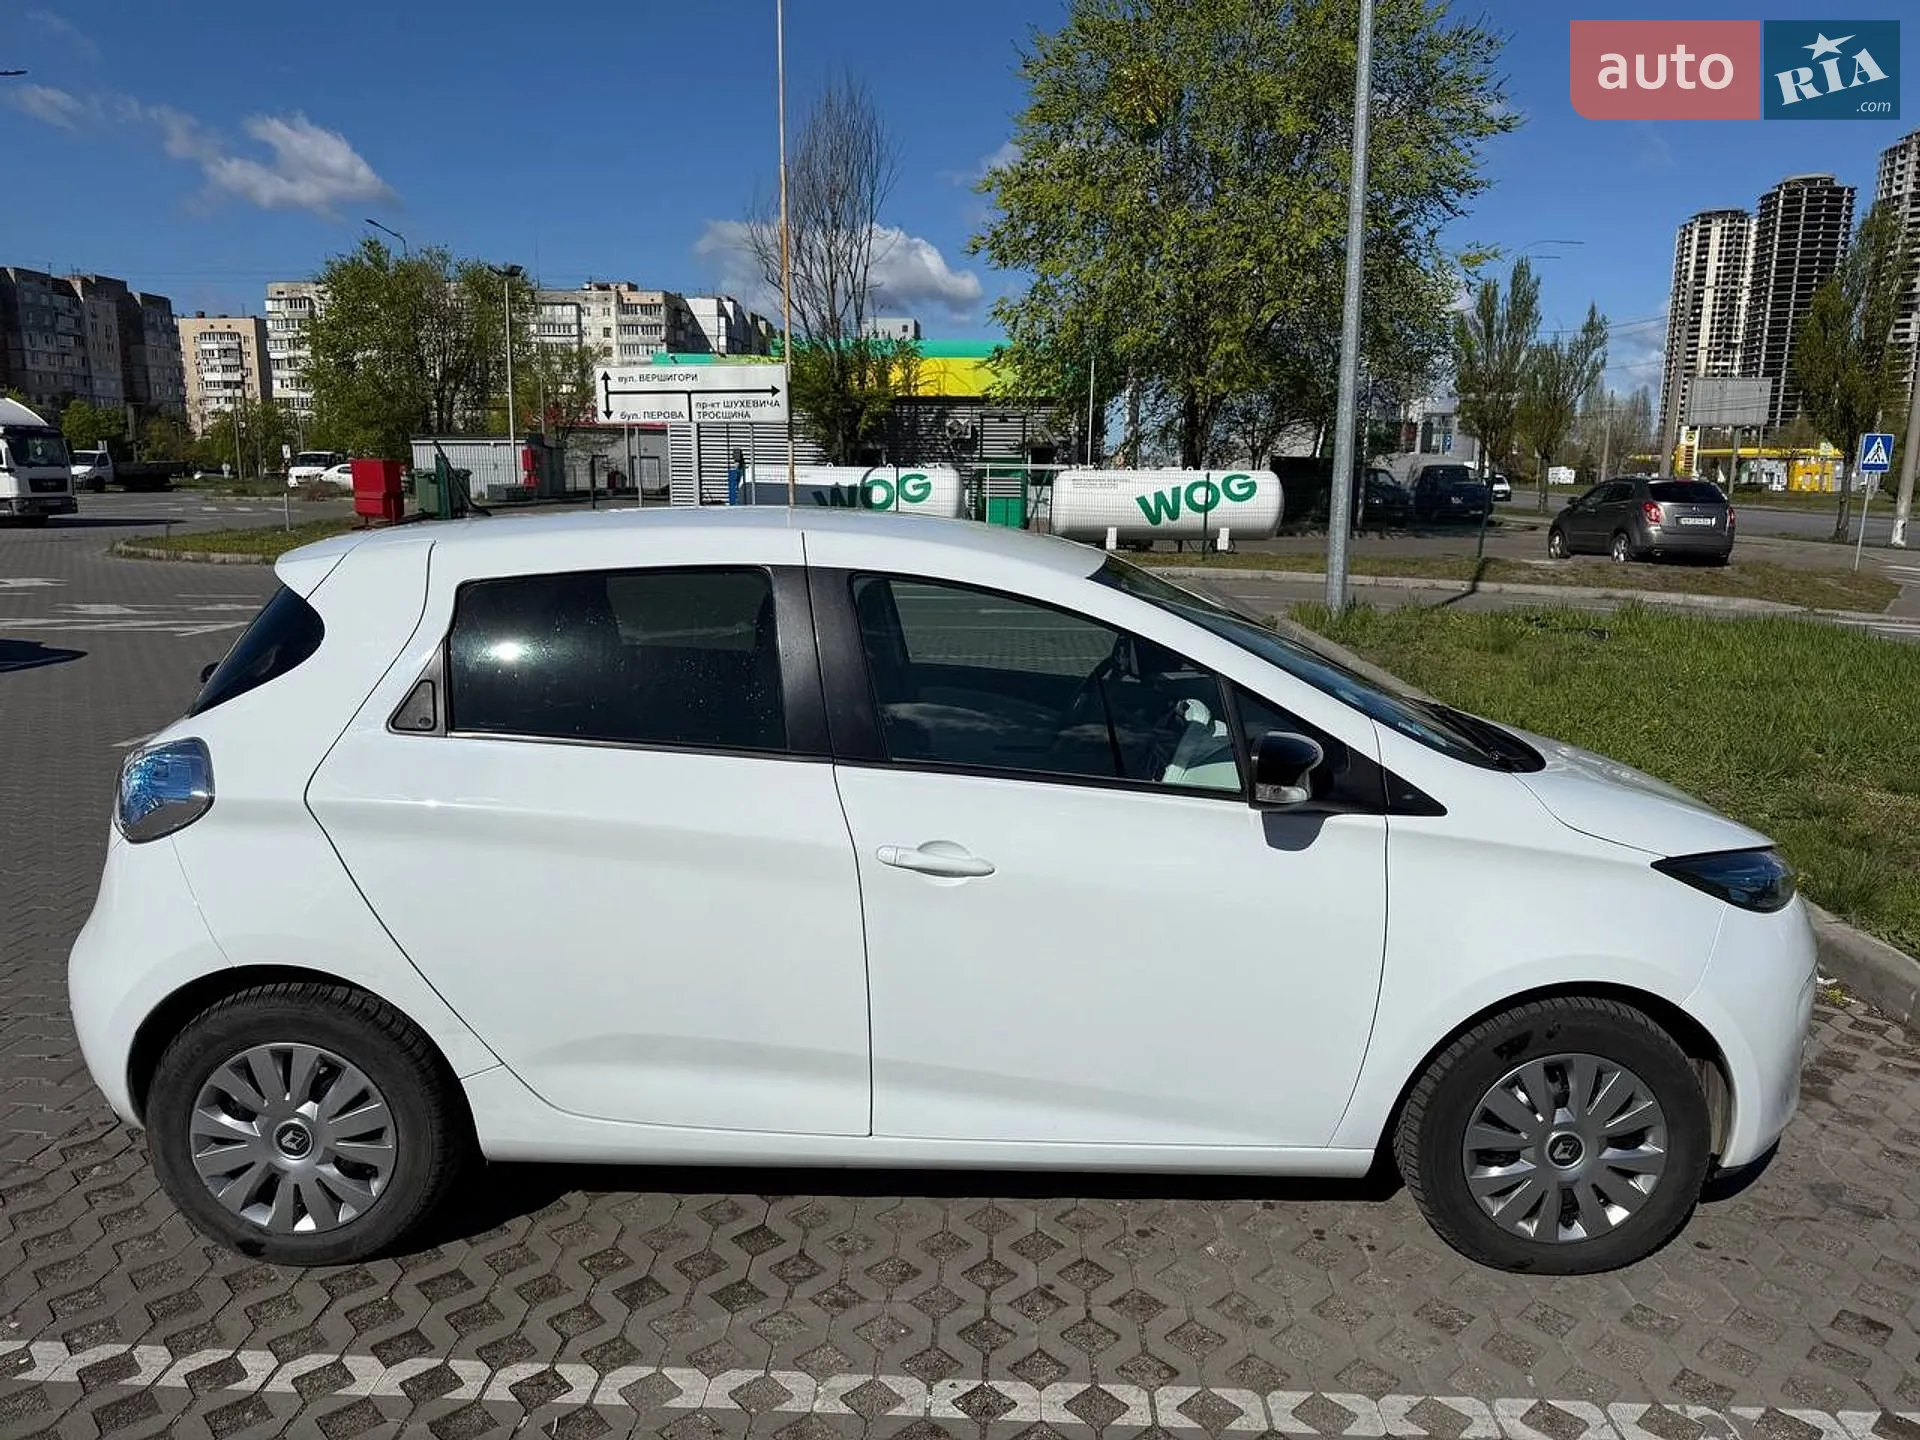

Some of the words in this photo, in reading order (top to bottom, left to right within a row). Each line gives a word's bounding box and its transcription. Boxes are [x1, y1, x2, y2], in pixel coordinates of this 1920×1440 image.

[618, 376, 637, 384] вул.
[639, 373, 698, 382] ВЕРШИГОРИ
[696, 402, 720, 410] пр-кт
[723, 400, 780, 409] ШУХЕВИЧА
[620, 411, 640, 420] бул.
[643, 411, 684, 420] ПЕРОВА
[812, 473, 932, 511] WOG
[1136, 473, 1258, 526] WOG
